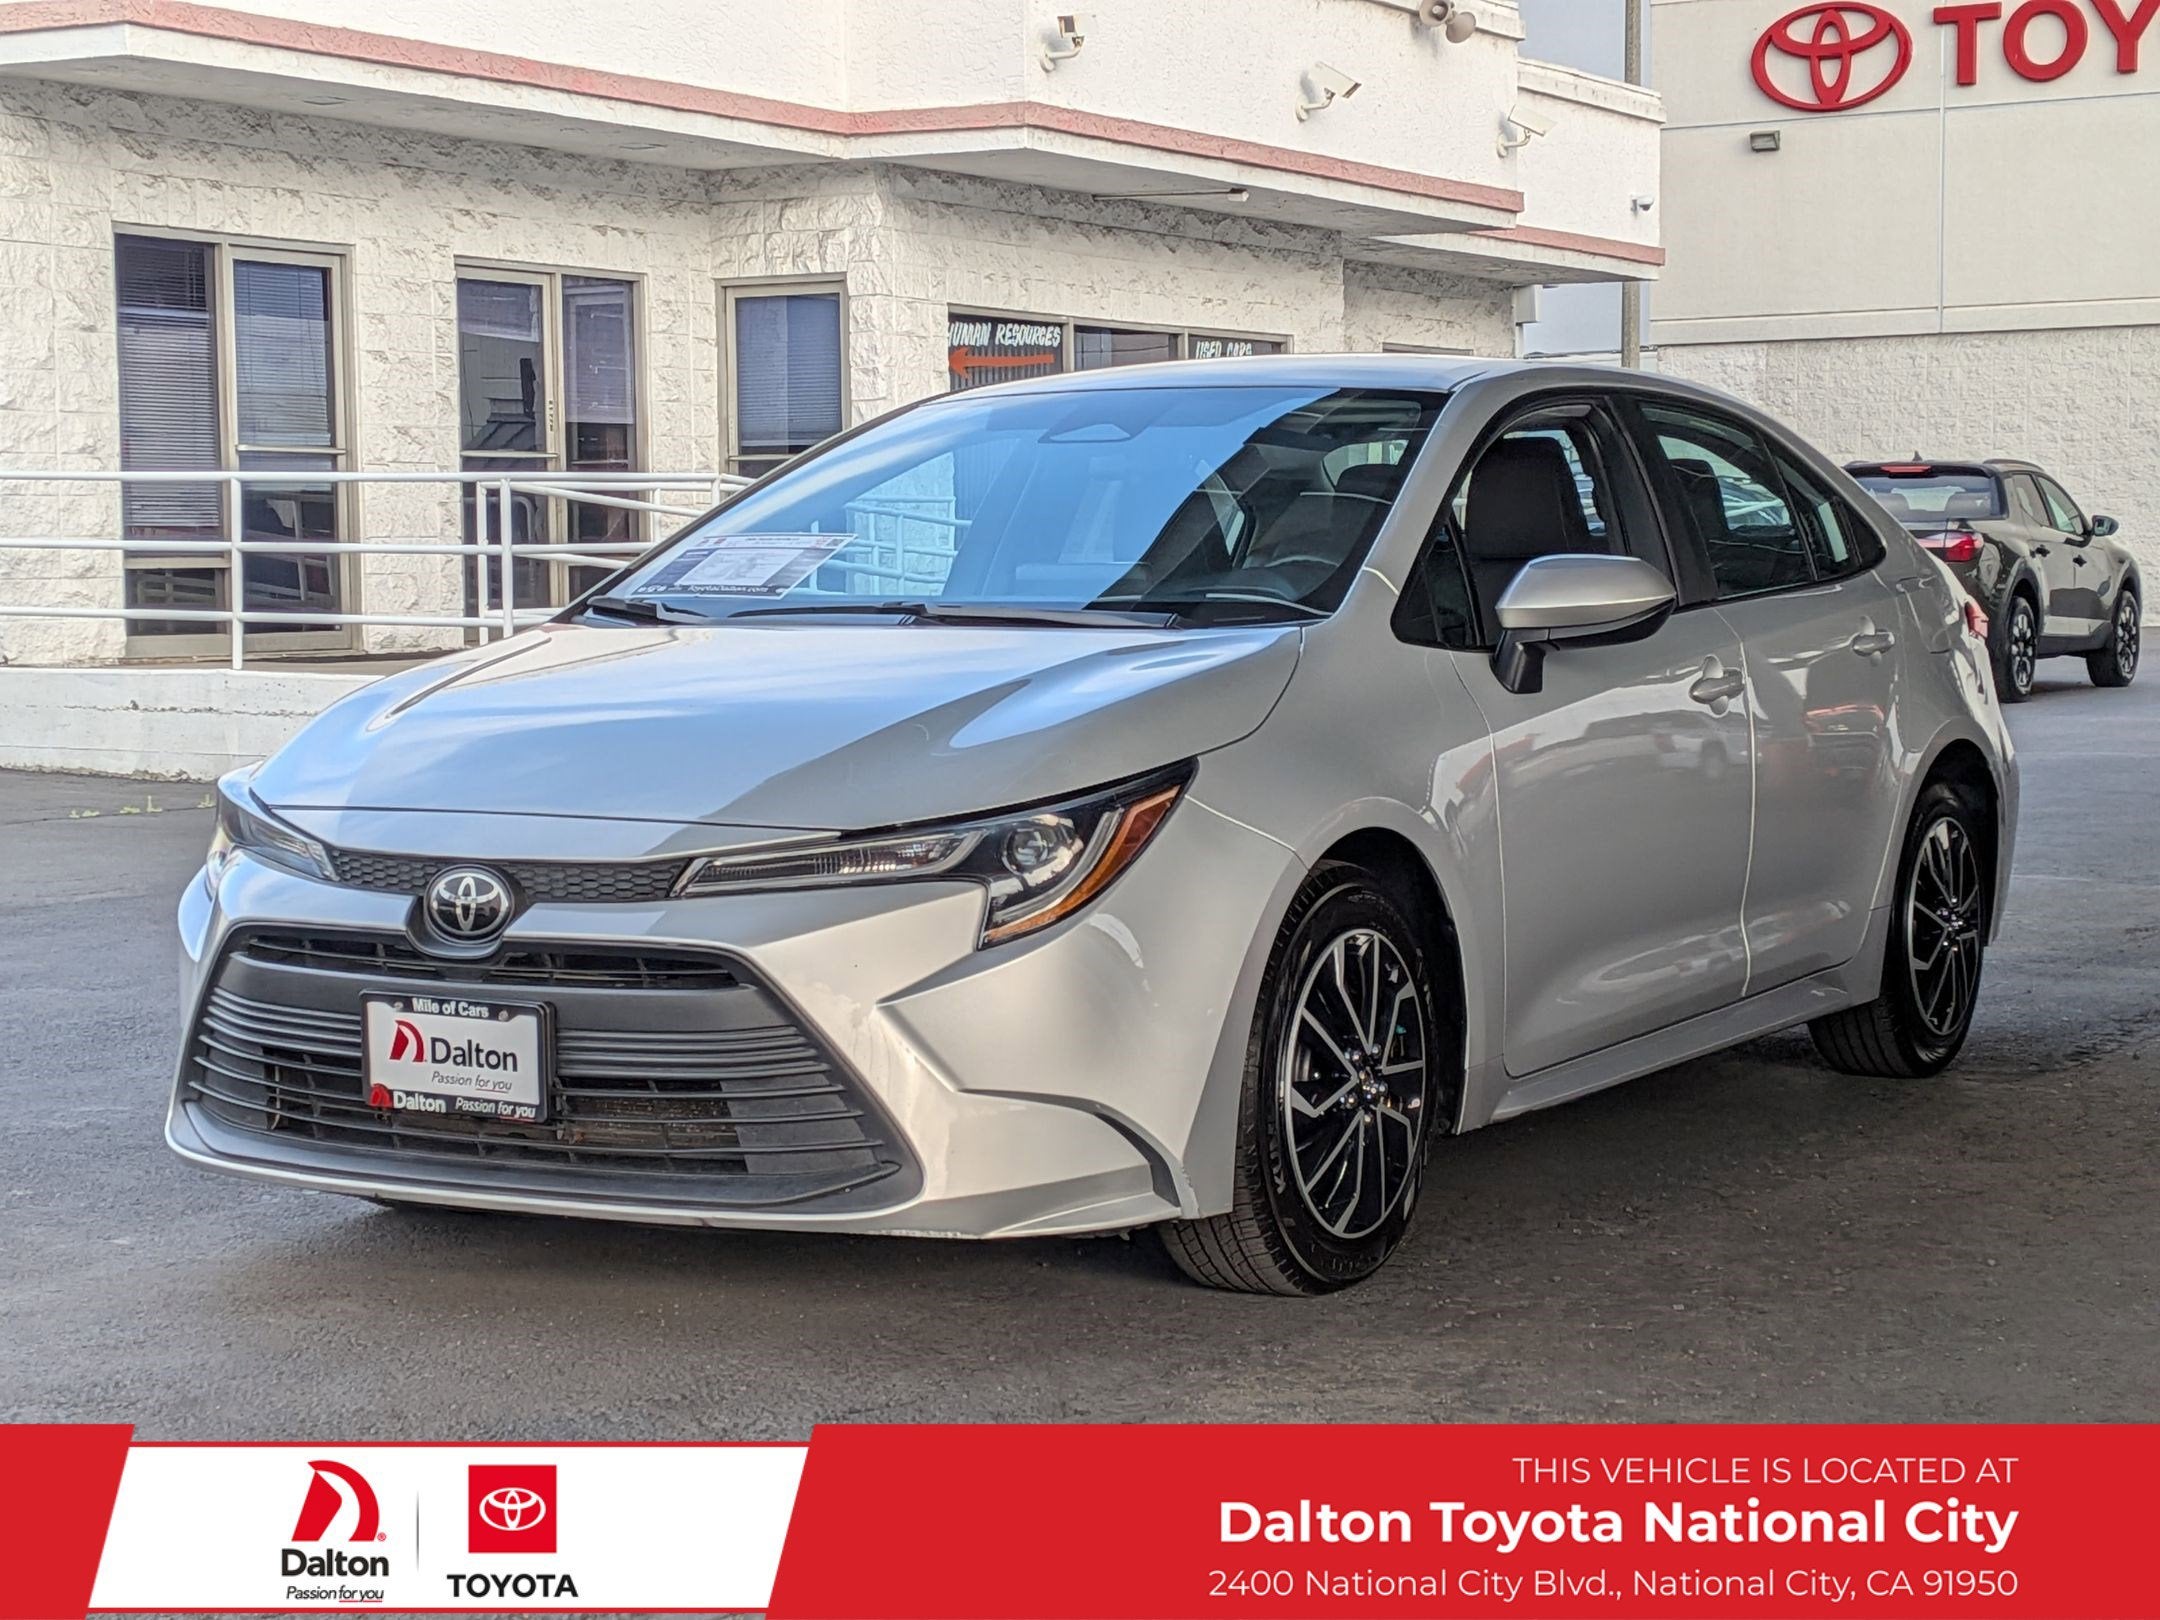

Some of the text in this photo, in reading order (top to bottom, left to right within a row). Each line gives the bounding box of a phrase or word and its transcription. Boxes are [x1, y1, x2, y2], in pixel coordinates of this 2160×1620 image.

[1933, 0, 2160, 85] TOY
[995, 323, 1061, 348] RESOURCES
[412, 998, 489, 1018] Mile of Cars
[430, 1036, 518, 1072] Dalton
[431, 1070, 512, 1092] Passion for you
[393, 1090, 536, 1120] Dalton Passion for you
